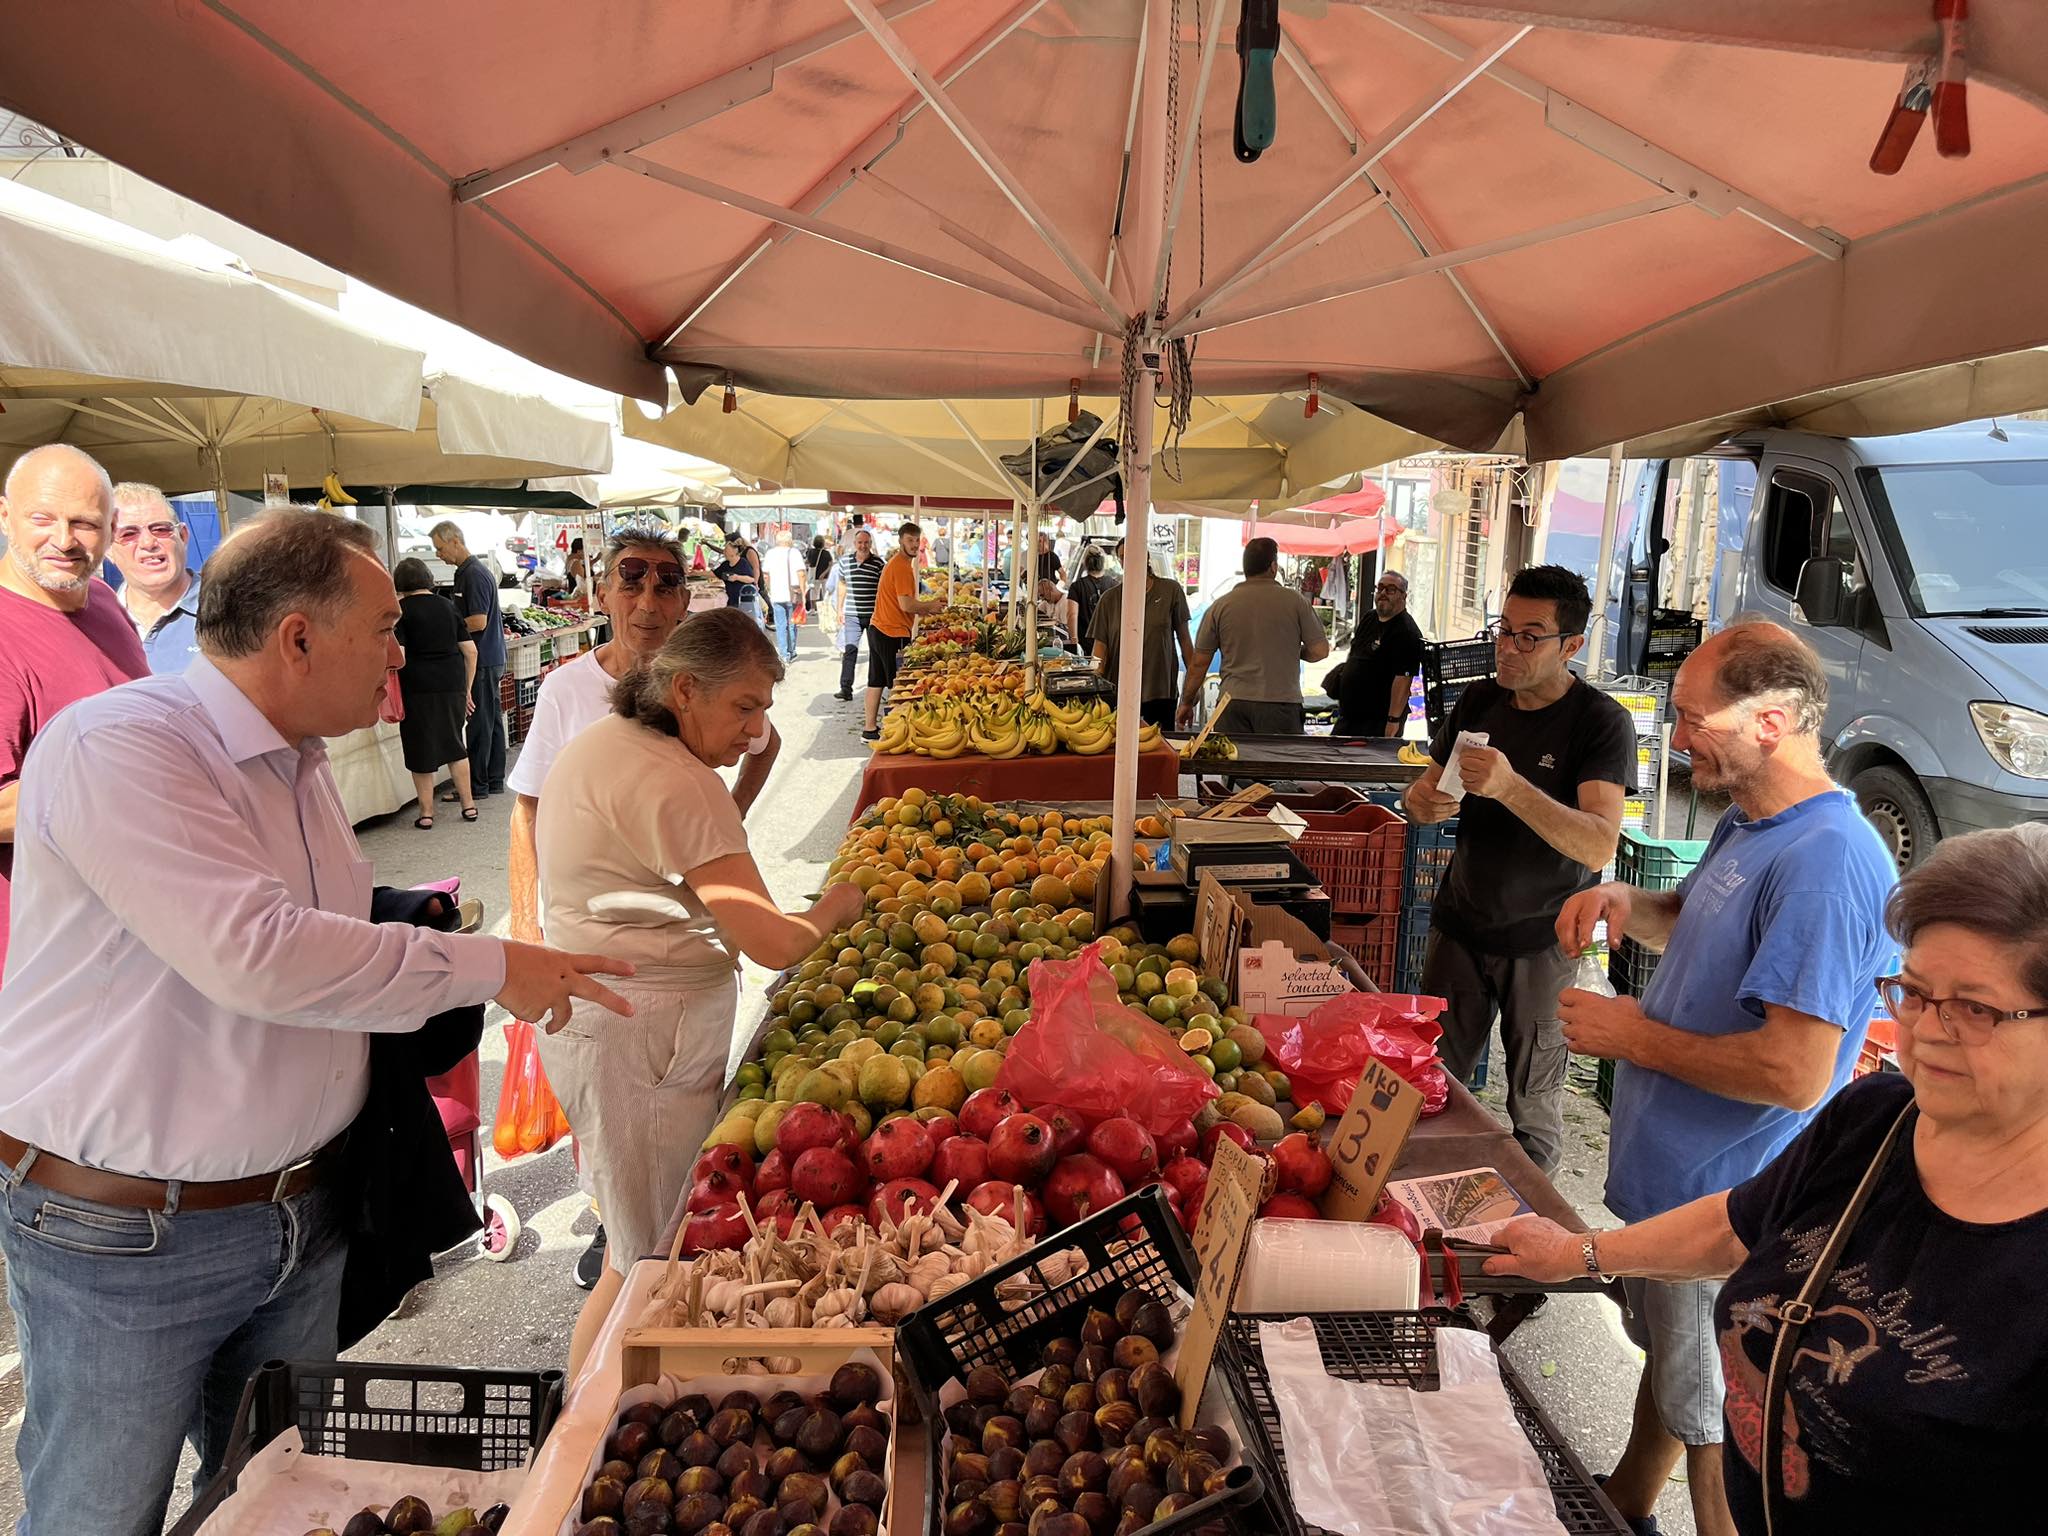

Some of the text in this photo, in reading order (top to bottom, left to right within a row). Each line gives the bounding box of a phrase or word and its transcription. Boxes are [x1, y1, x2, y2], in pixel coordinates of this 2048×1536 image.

[555, 530, 569, 552] 4
[1281, 967, 1332, 981] selected
[1286, 982, 1346, 994] tomatoes
[1337, 1108, 1371, 1164] 3
